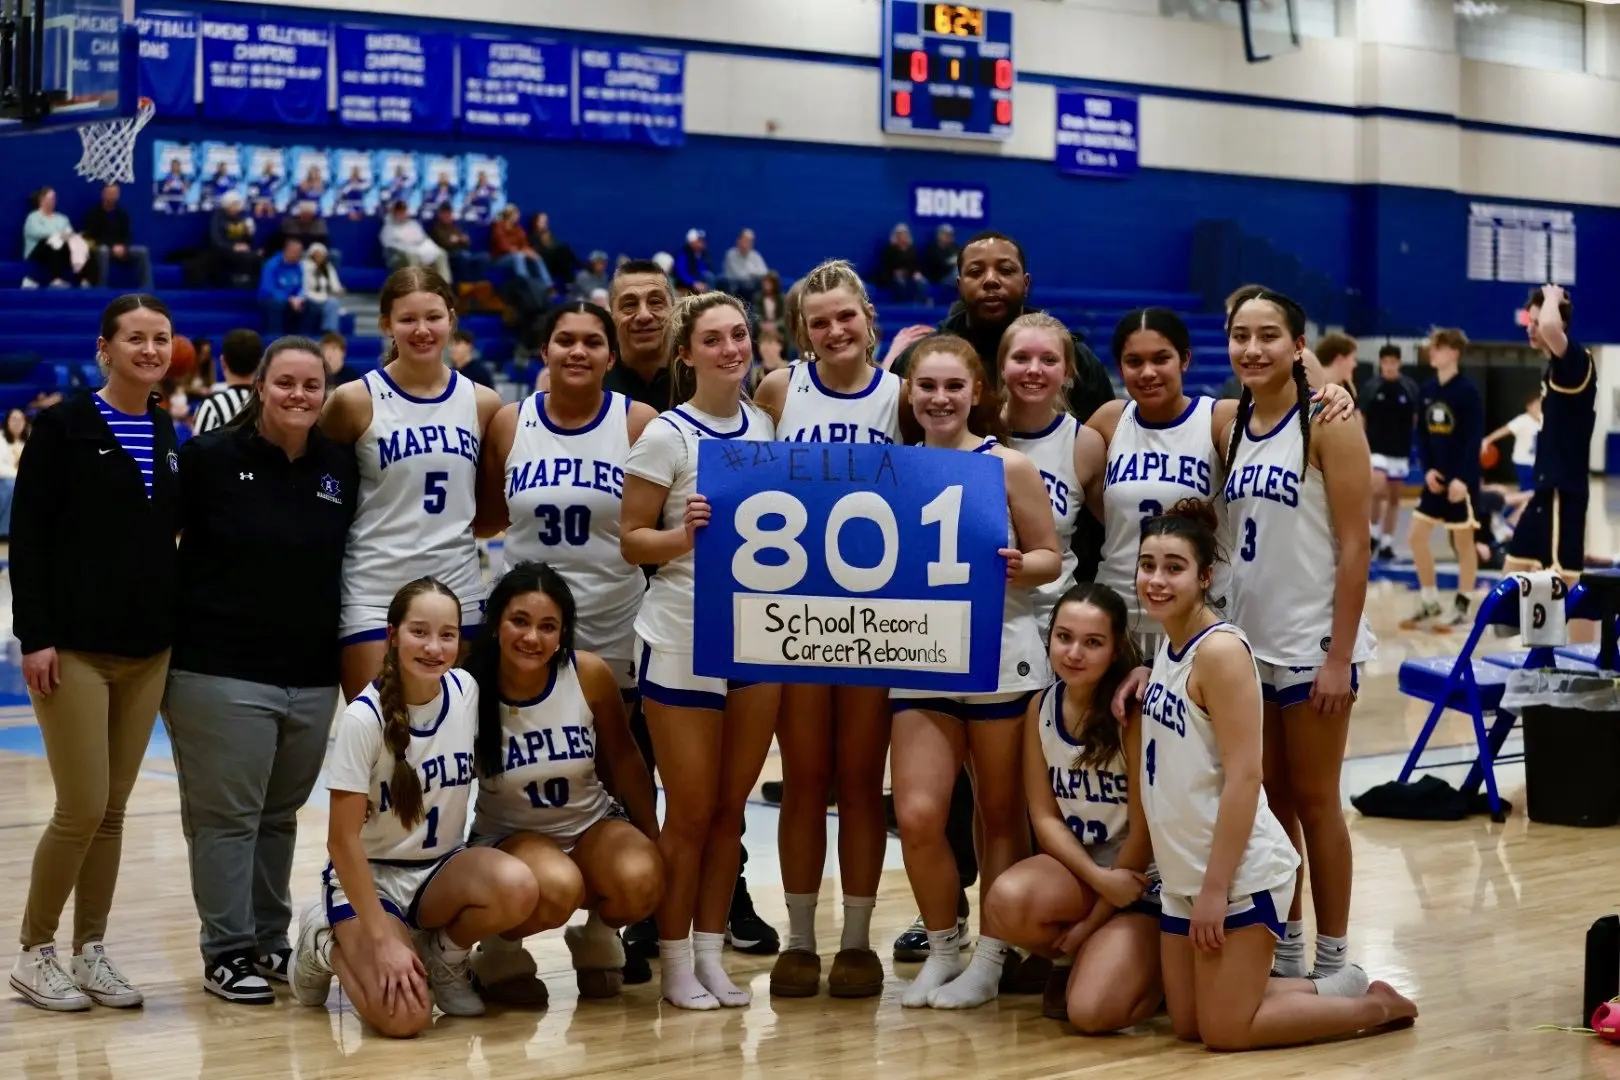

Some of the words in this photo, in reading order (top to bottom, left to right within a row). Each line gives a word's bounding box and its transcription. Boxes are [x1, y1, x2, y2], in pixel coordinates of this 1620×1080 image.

[911, 51, 928, 82] 0
[950, 59, 960, 80] 1
[995, 58, 1012, 90] 0
[916, 187, 984, 218] HOME
[377, 424, 480, 471] MAPLES
[721, 441, 778, 471] #21
[789, 447, 898, 486] ELLA
[423, 471, 448, 514] 5
[509, 458, 624, 499] MAPLES
[1103, 452, 1211, 496] MAPLES
[534, 504, 591, 546] 30
[732, 485, 970, 593] 801
[1240, 517, 1256, 562] 3
[765, 602, 855, 636] School
[859, 607, 928, 635] Record
[781, 636, 853, 661] Career
[853, 638, 947, 665] Rebounds
[523, 777, 570, 808] 10
[422, 806, 439, 849] 1
